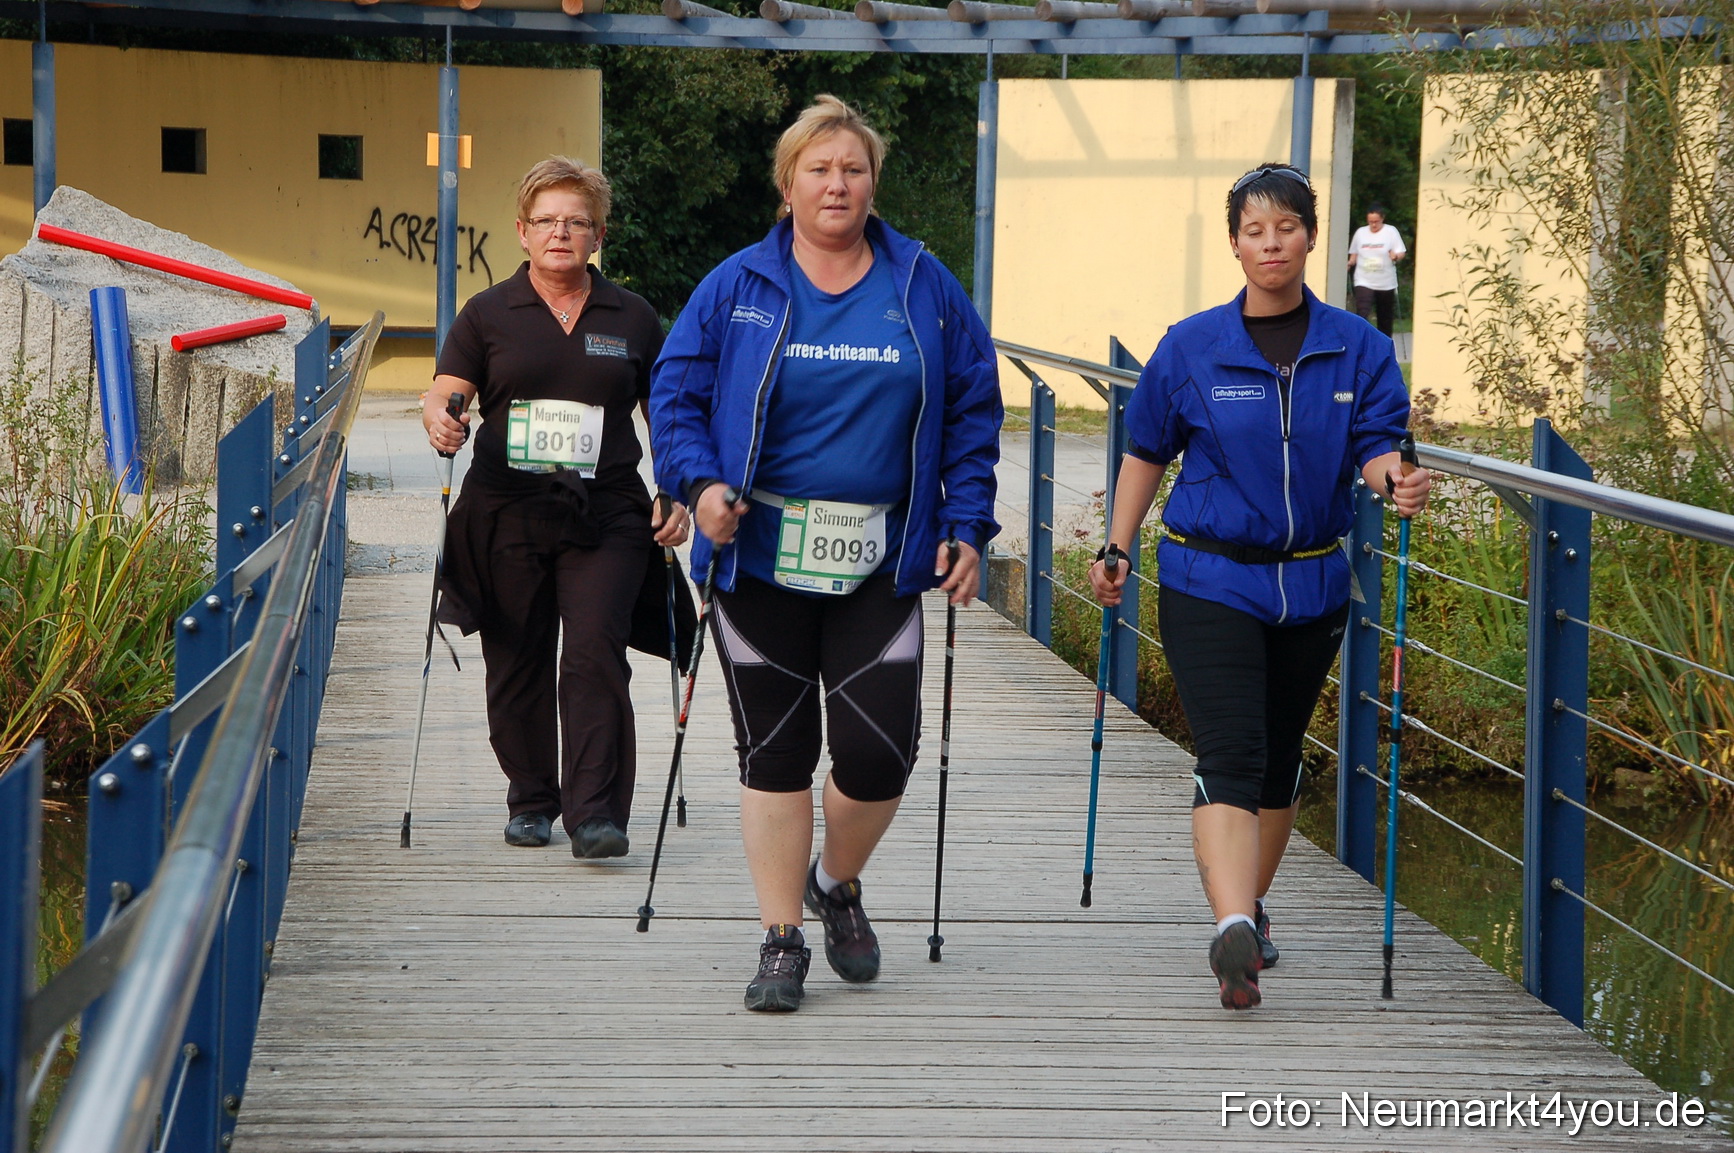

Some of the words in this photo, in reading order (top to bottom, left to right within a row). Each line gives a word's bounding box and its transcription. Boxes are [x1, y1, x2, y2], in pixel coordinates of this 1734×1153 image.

[535, 407, 581, 424] Martina
[535, 430, 594, 454] 8019
[813, 507, 864, 528] Simone
[812, 536, 878, 564] 8093
